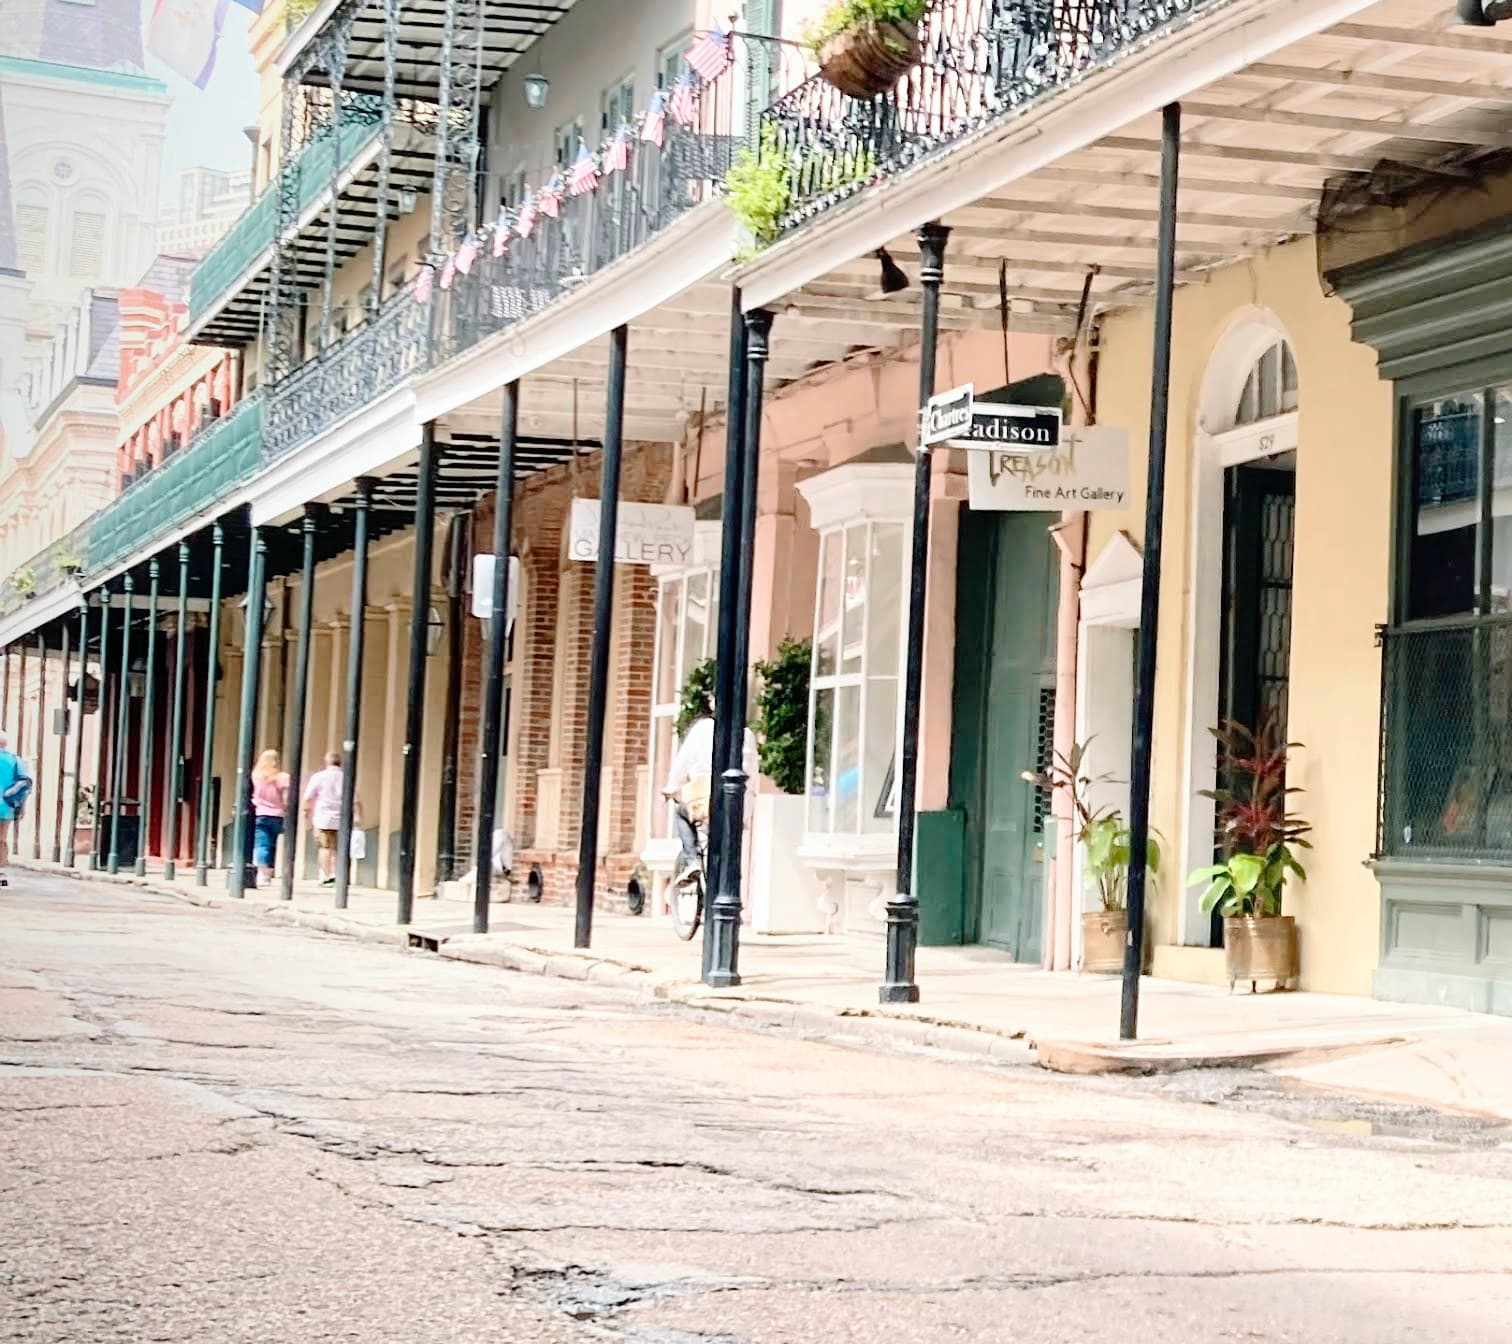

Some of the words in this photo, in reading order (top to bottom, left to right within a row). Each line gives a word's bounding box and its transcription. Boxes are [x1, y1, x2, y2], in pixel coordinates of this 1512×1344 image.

[966, 418, 1050, 443] adison
[1025, 485, 1050, 499] Fine
[1055, 487, 1077, 499] Art
[1080, 487, 1124, 503] Gallery
[574, 538, 692, 562] GLERY
